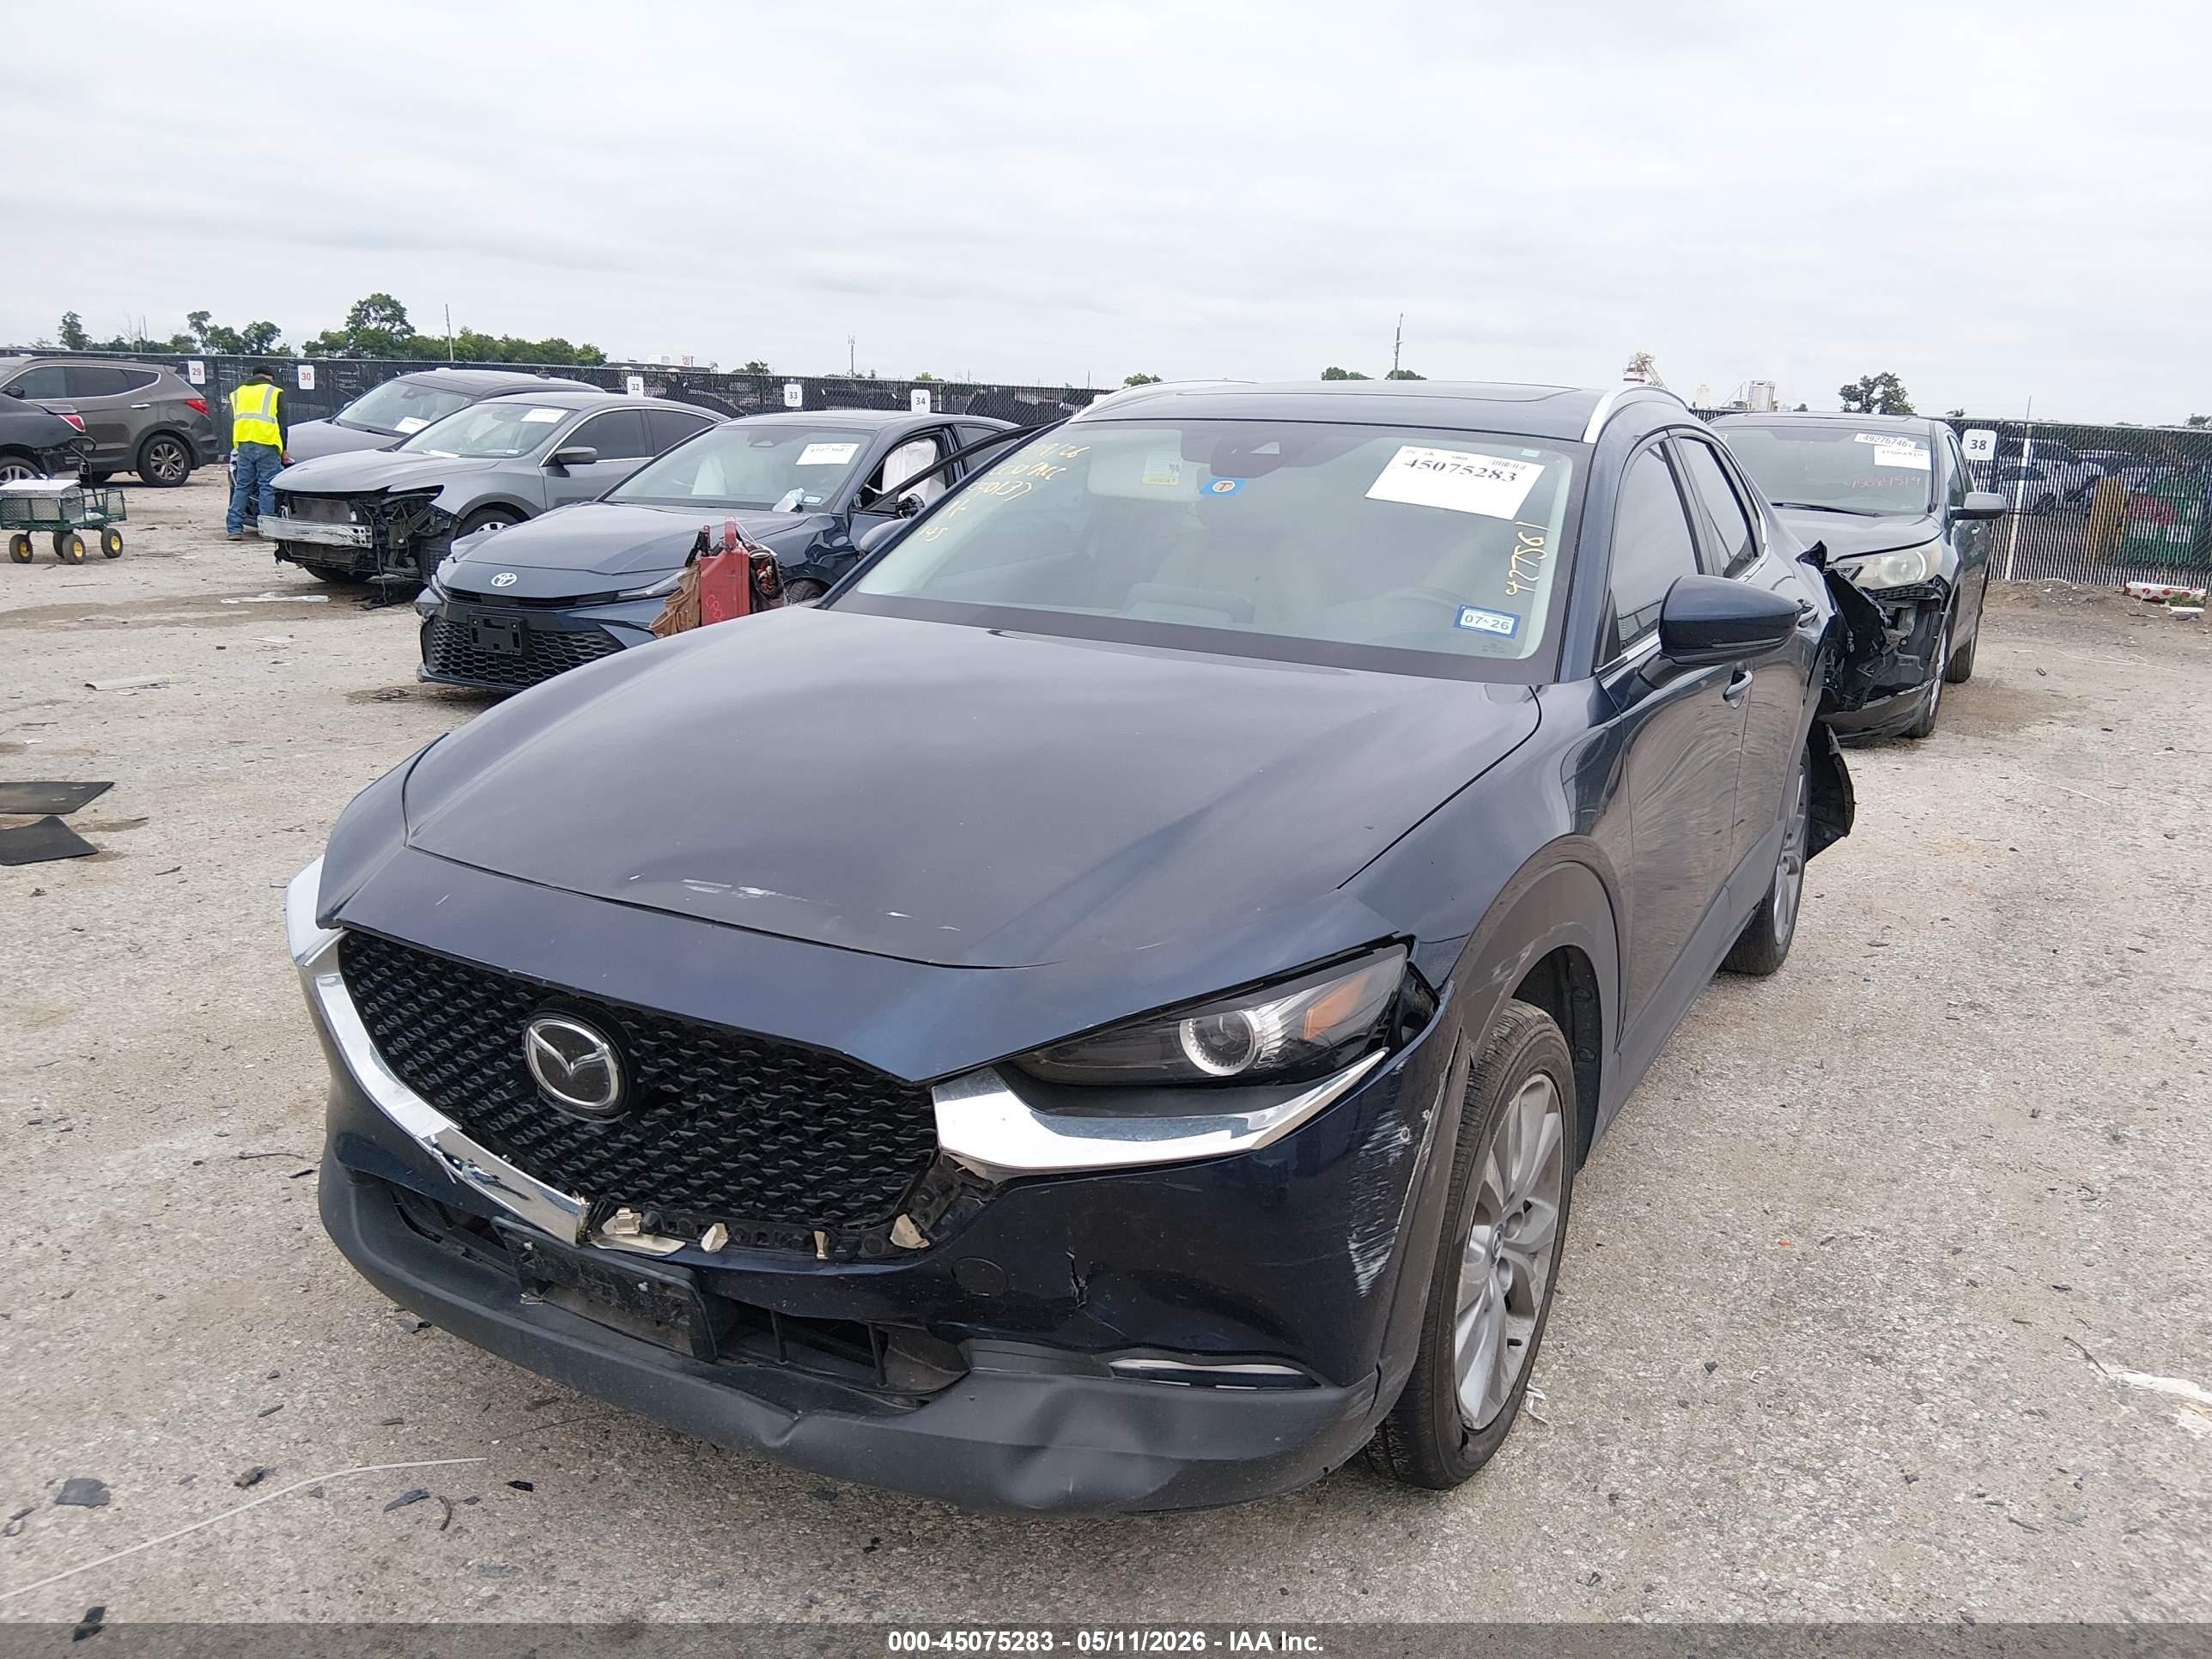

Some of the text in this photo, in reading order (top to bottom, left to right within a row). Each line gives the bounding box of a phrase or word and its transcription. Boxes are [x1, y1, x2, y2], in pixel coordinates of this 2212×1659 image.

[191, 368, 202, 376] 29
[301, 372, 312, 381] 30
[788, 391, 799, 399] 33
[915, 397, 927, 405] 34
[1968, 439, 1988, 451] 38
[1403, 458, 1518, 483] 45075283
